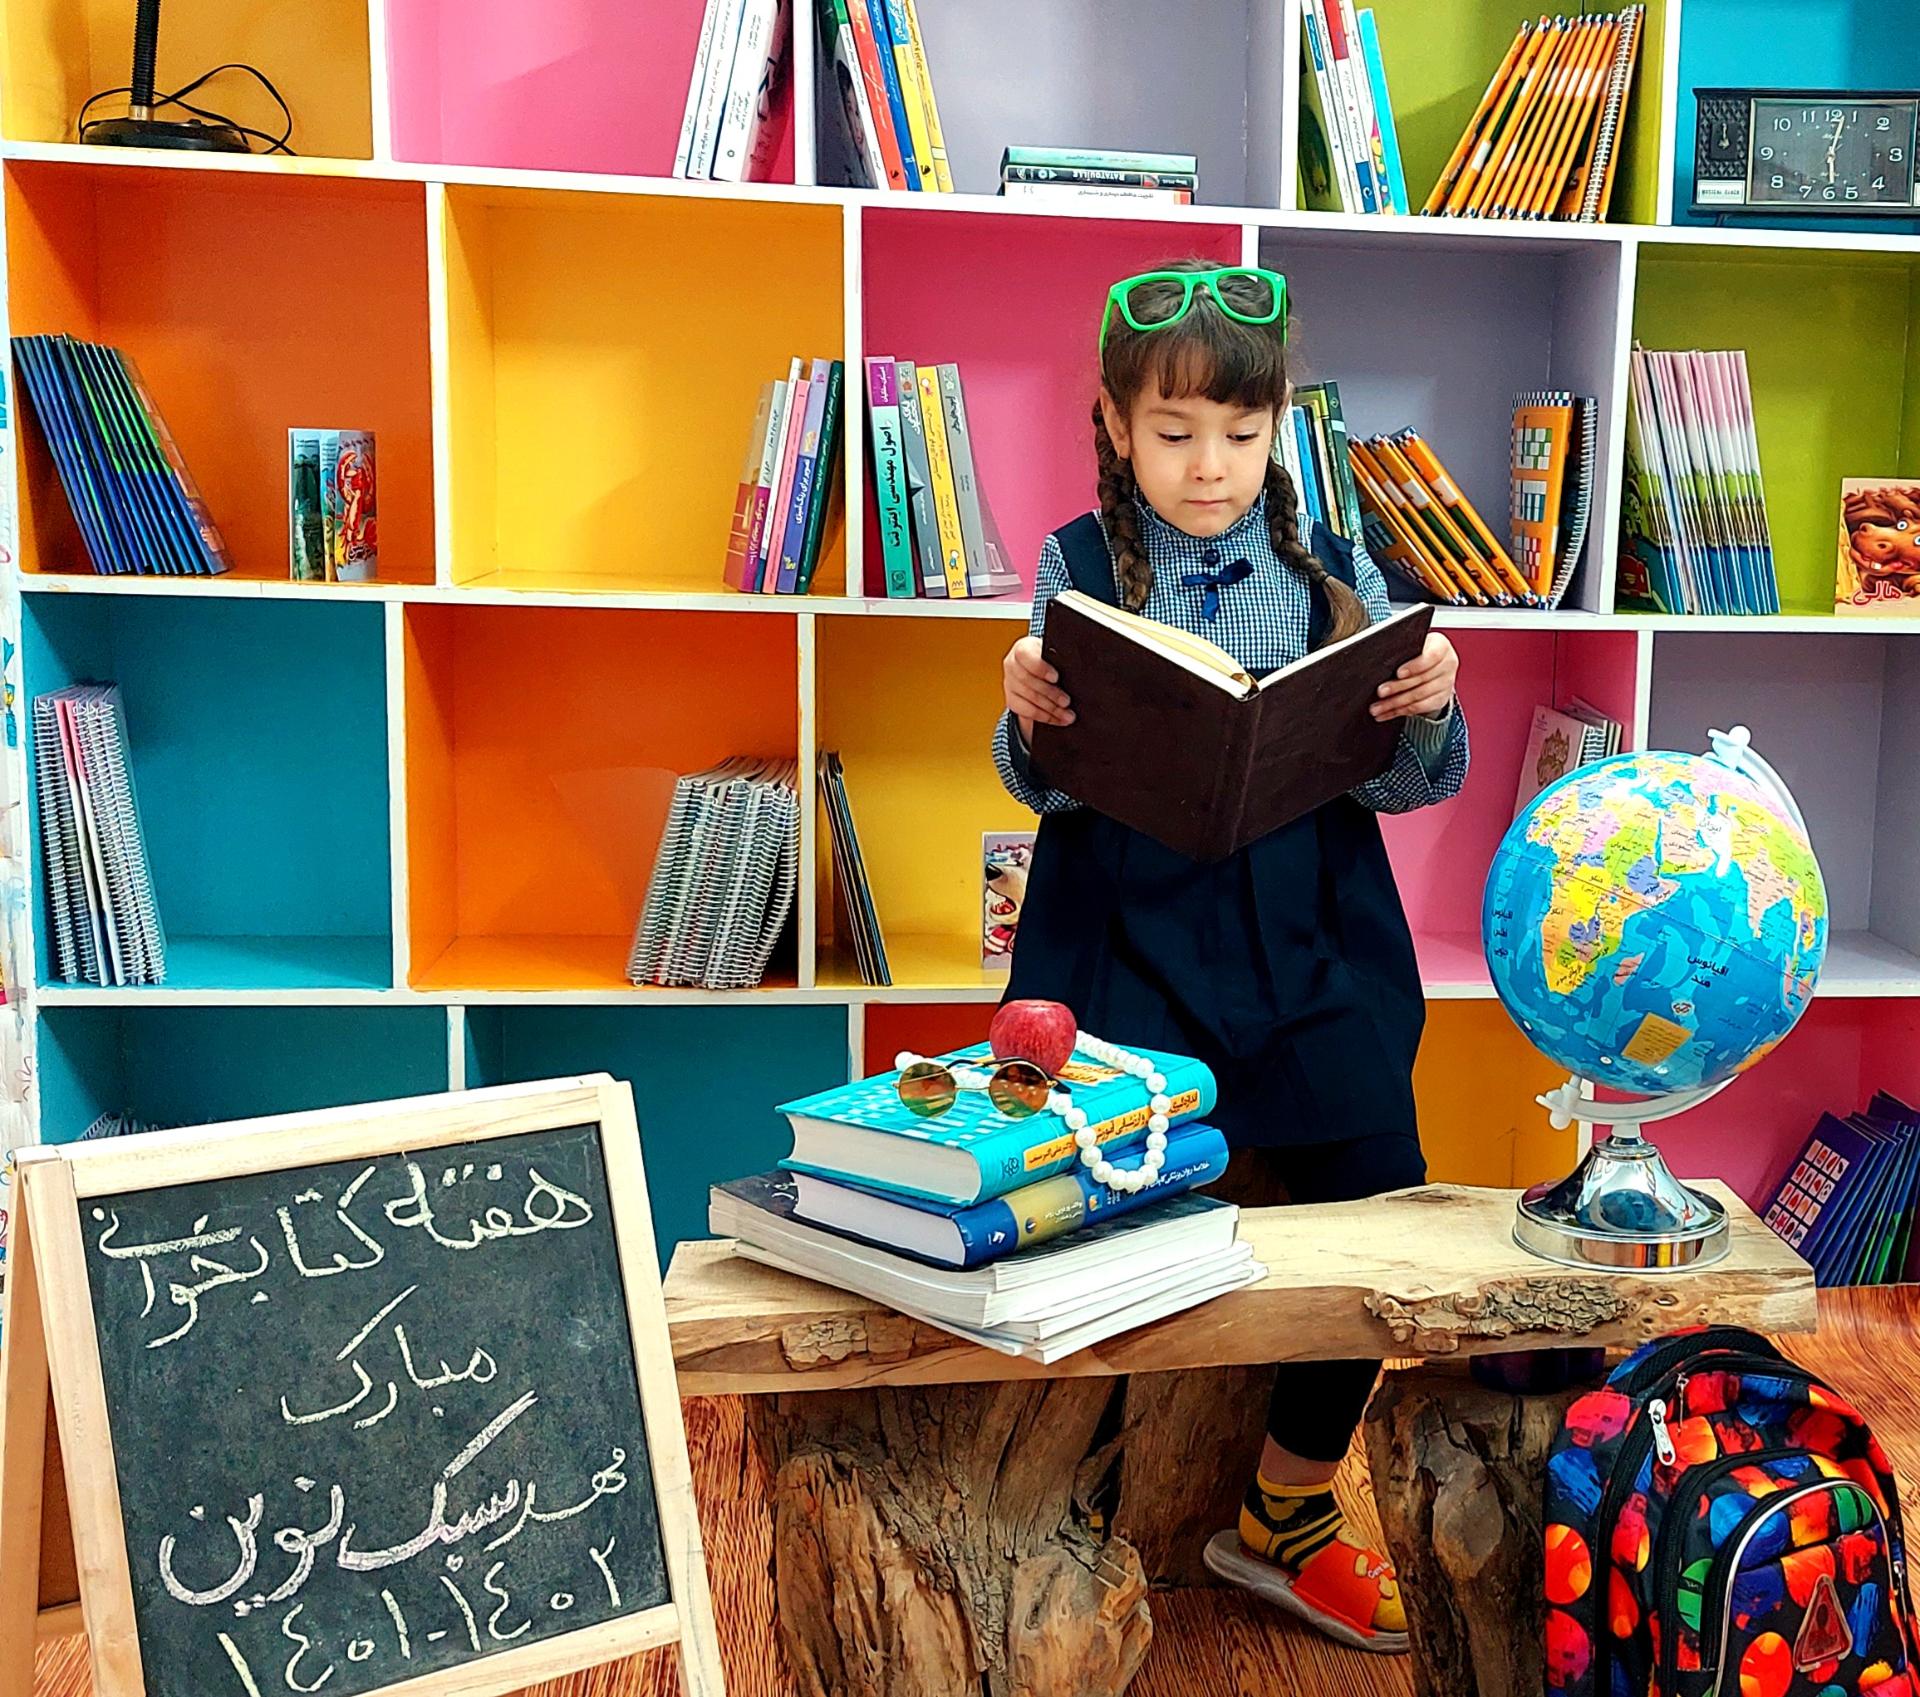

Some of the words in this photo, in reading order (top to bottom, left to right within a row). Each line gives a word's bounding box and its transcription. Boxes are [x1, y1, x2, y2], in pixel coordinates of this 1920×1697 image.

[1802, 110, 1816, 123] 11
[1825, 109, 1843, 123] 12
[1852, 110, 1858, 123] 1
[1774, 117, 1791, 132] 10
[1876, 117, 1890, 131] 2
[1760, 146, 1774, 161] 9
[1889, 148, 1903, 162] 3
[1770, 175, 1784, 189] 8
[1872, 176, 1885, 190] 4
[1799, 185, 1813, 199] 7
[1822, 186, 1836, 200] 6
[1845, 186, 1859, 200] 5
[879, 425, 897, 458] اصول
[881, 458, 901, 505] مهندسی
[885, 506, 904, 548] اینترنت
[1687, 955, 1729, 976] اقیانوس
[1691, 975, 1711, 989] هند
[384, 1161, 594, 1251] هفته
[280, 1284, 499, 1429] مبارک
[159, 1475, 344, 1617] نوین
